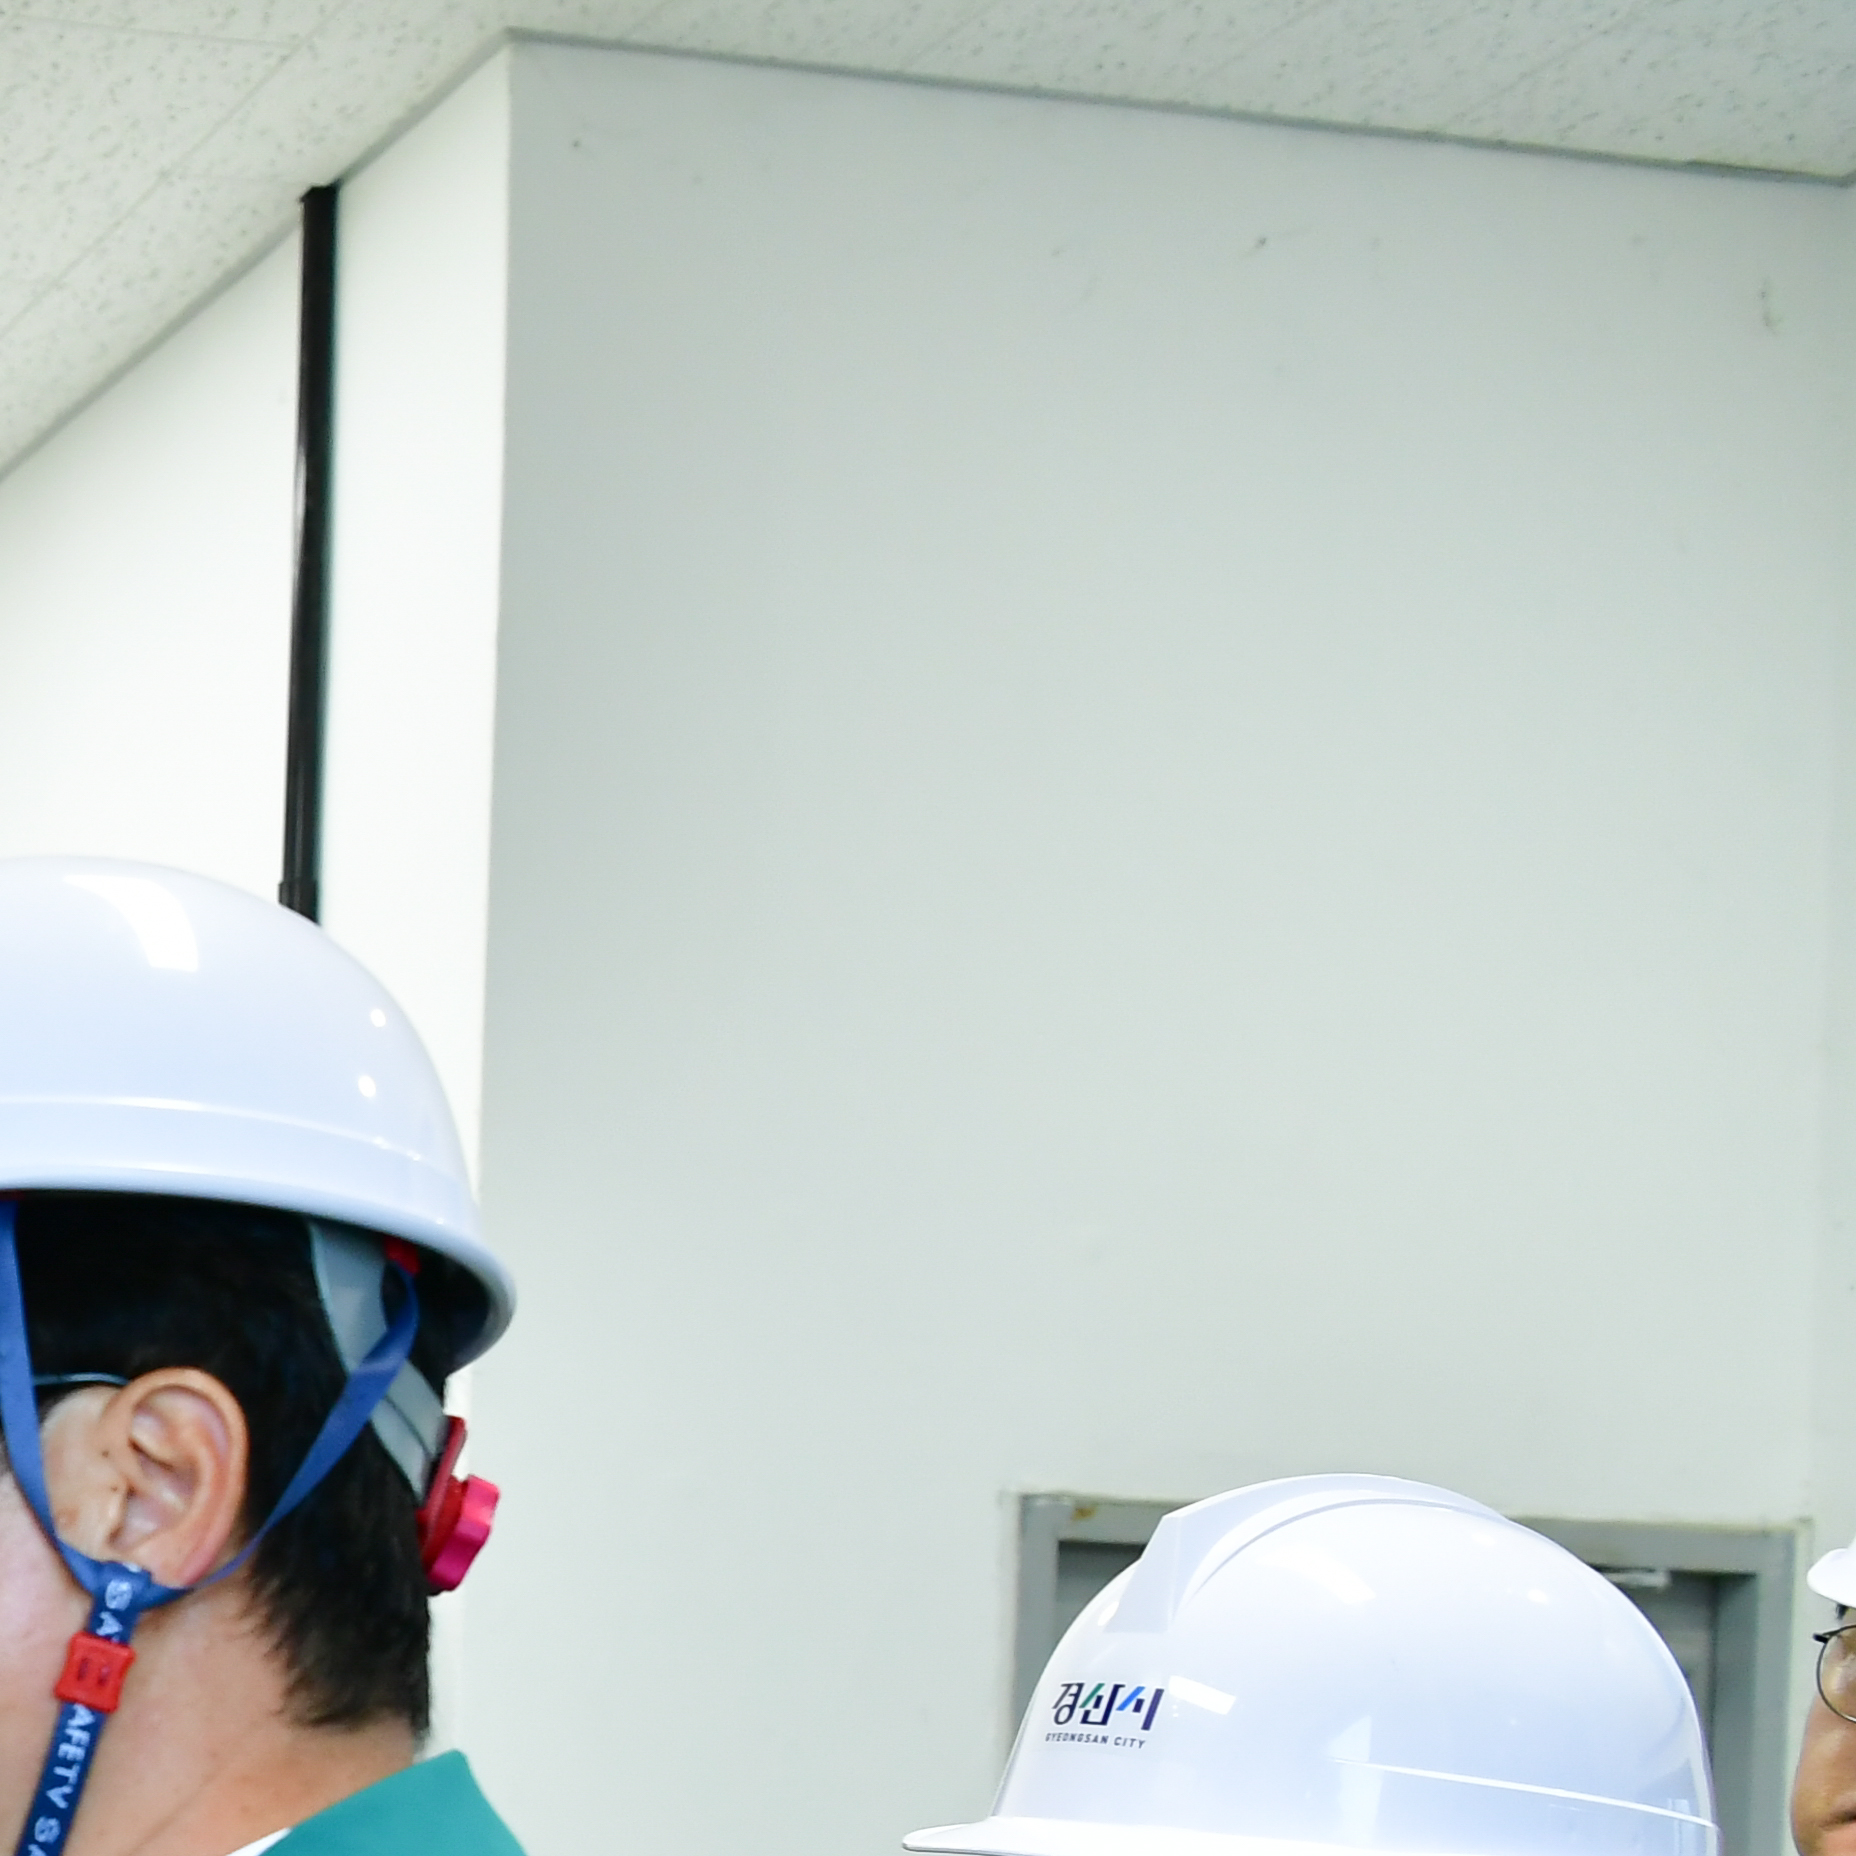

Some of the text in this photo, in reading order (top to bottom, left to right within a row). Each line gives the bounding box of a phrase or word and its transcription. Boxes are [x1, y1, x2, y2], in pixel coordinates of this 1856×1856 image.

[1052, 1683, 1165, 1731] 경산시
[47, 1704, 95, 1808] AFETY
[1045, 1733, 1146, 1748] GYEONGSAN CITY
